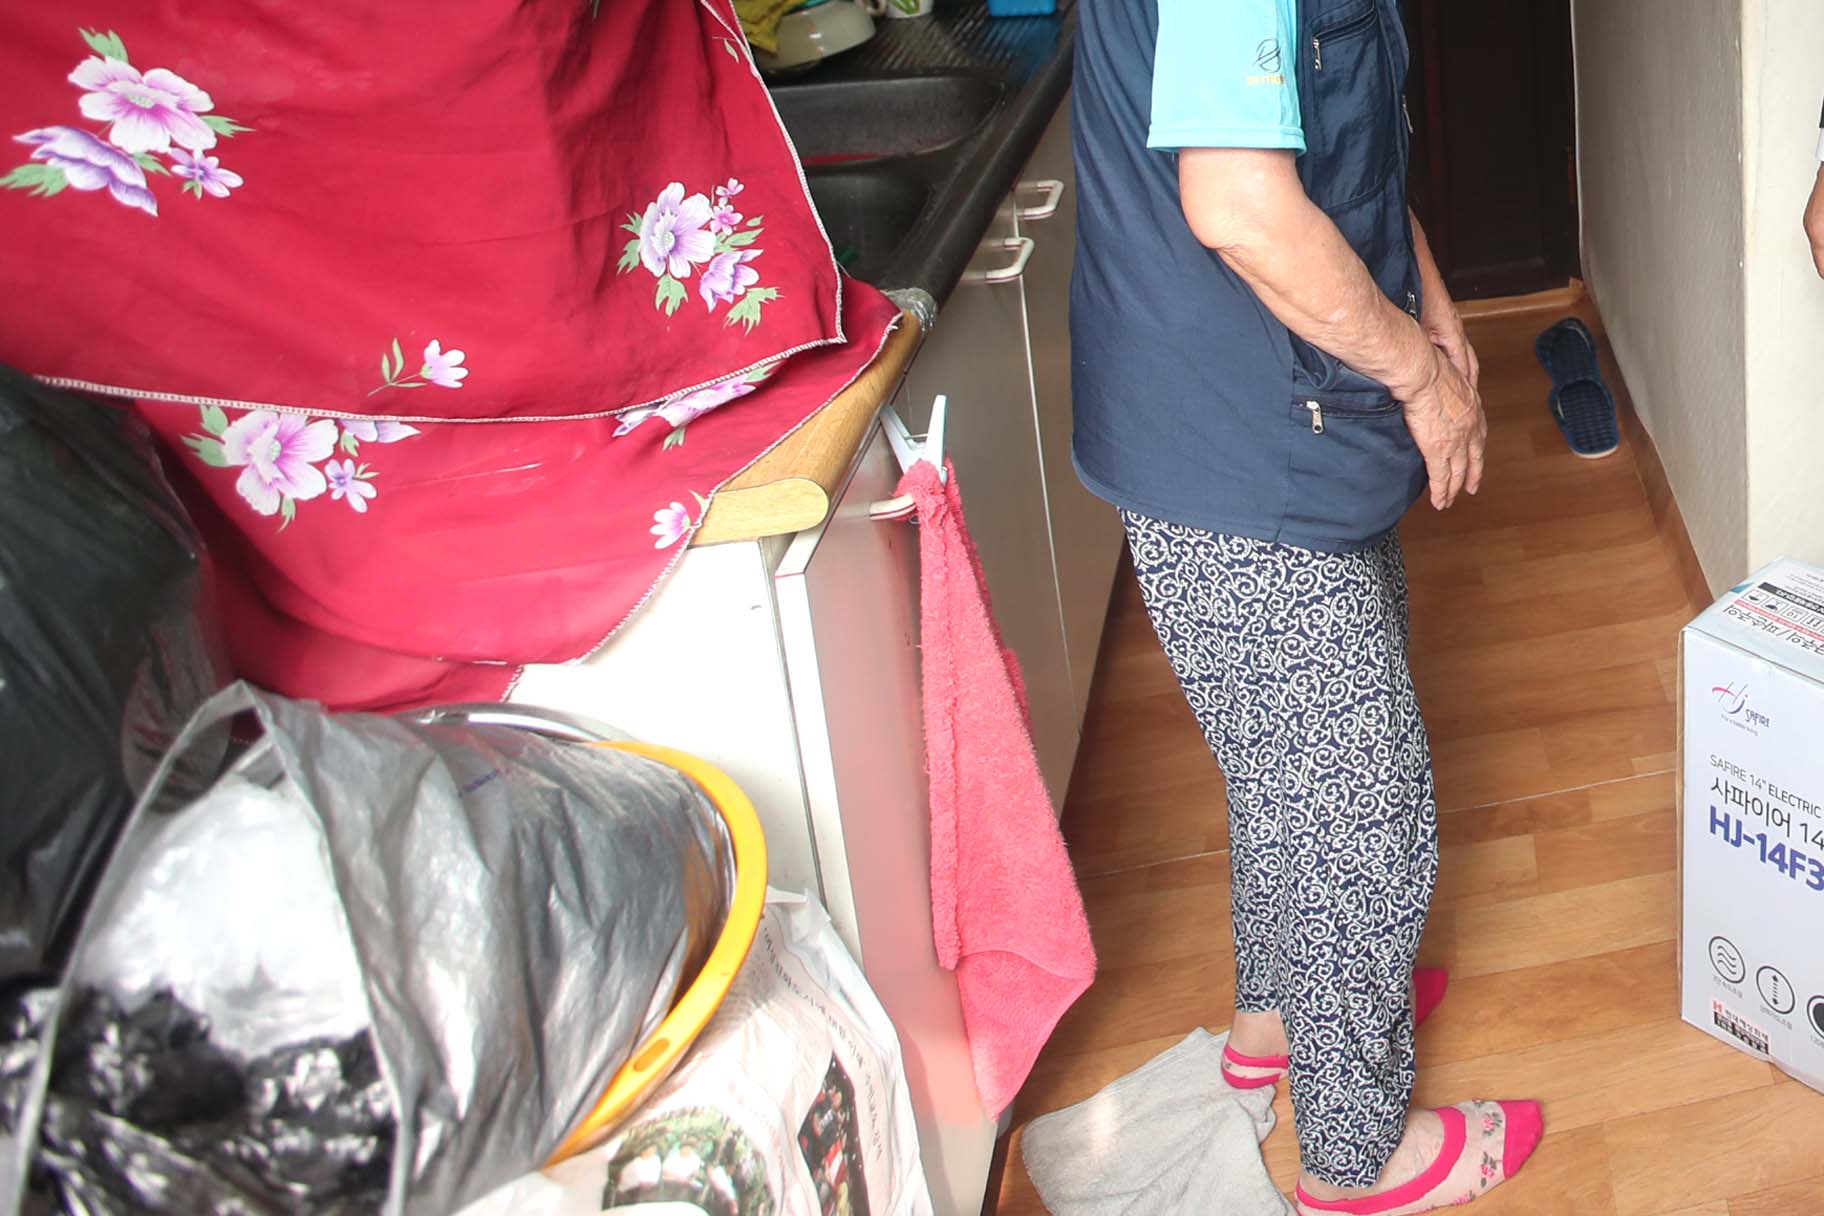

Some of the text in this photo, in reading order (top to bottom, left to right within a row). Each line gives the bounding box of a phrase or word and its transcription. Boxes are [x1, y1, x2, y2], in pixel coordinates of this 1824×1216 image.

[1723, 604, 1778, 636] 파손주의
[1710, 754, 1747, 783] SAFIRE
[1768, 783, 1822, 819] ELECTRIC
[1711, 776, 1791, 838] 사파이어
